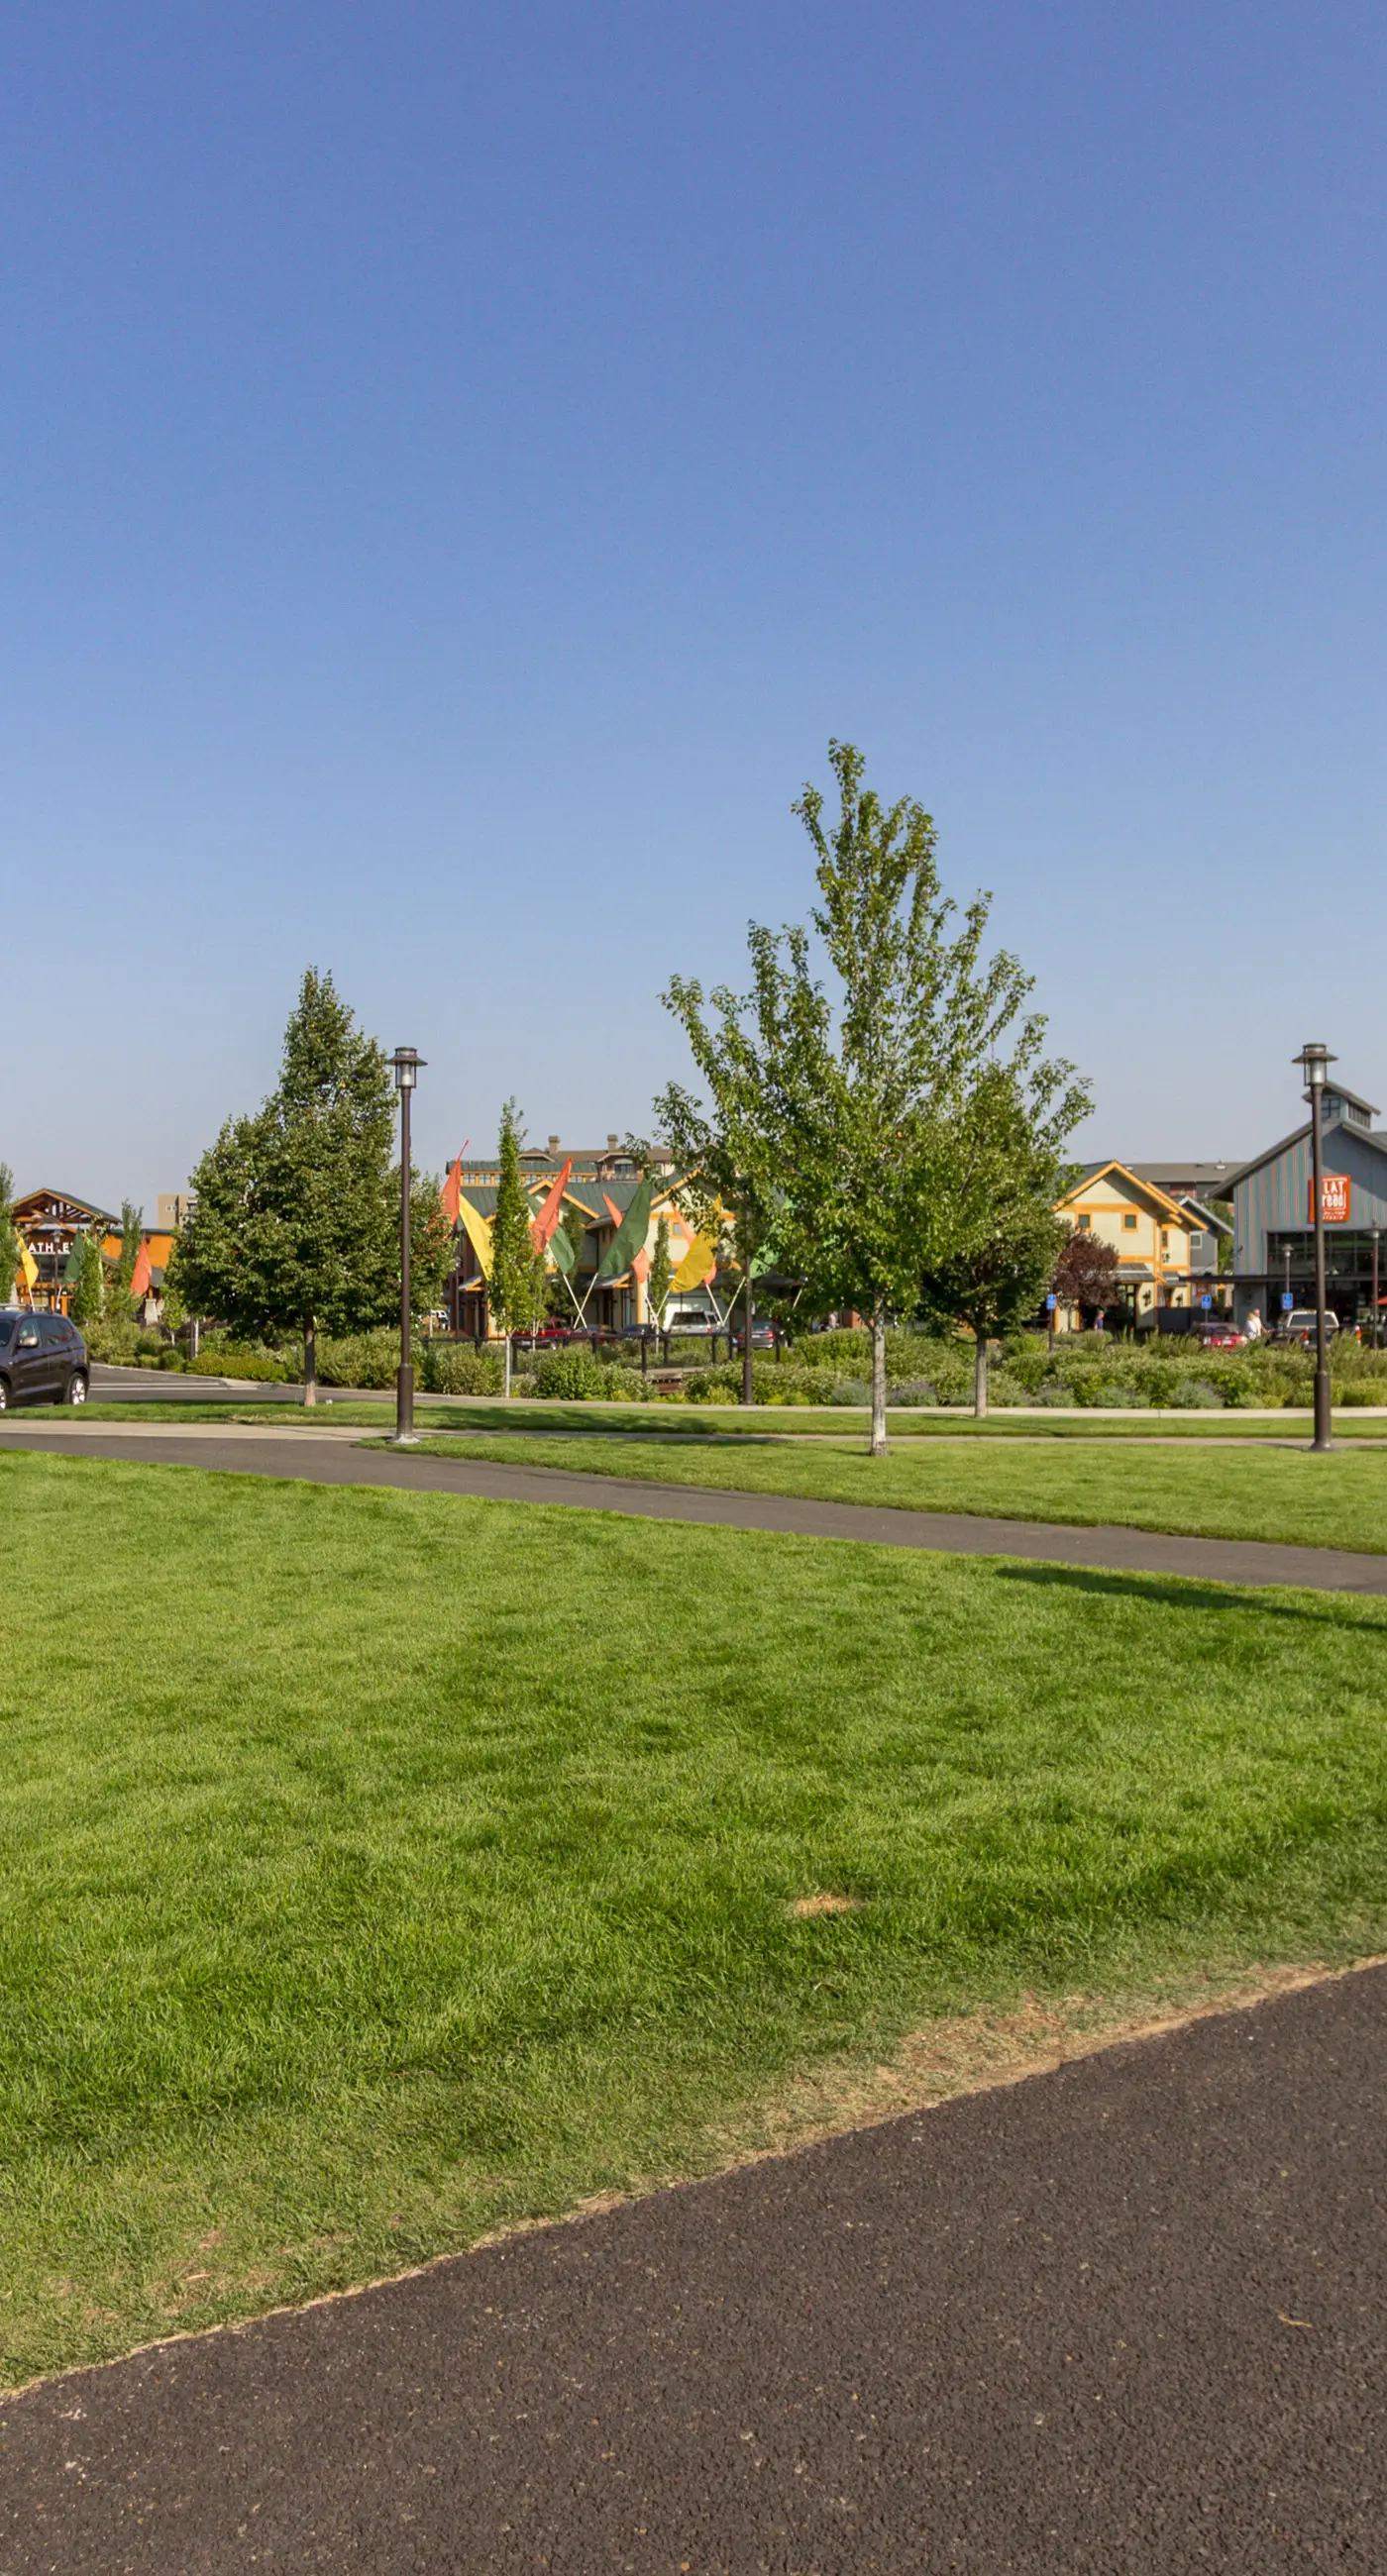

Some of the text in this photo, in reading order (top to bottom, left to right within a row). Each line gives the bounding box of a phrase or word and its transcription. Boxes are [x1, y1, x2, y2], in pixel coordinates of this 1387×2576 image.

[1324, 1181, 1343, 1194] LAT
[1322, 1192, 1343, 1207] read
[28, 1242, 74, 1253] ATHE
